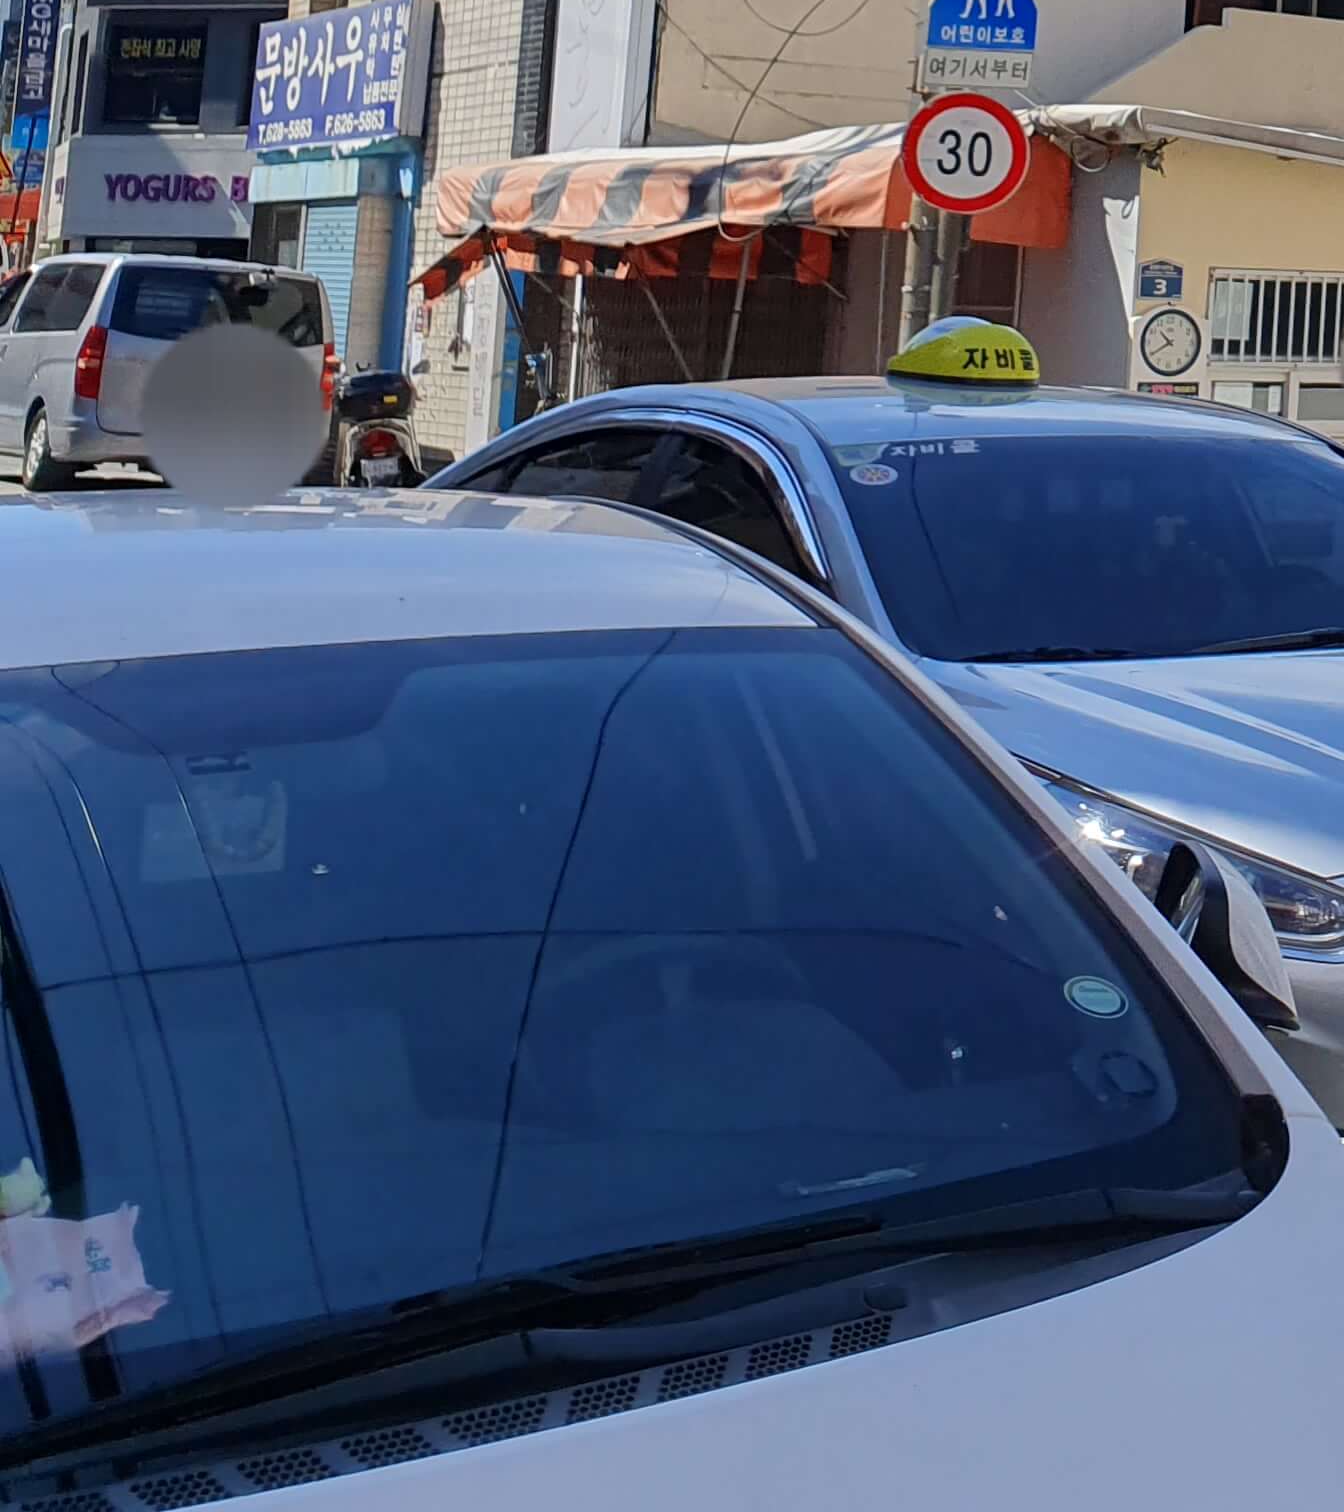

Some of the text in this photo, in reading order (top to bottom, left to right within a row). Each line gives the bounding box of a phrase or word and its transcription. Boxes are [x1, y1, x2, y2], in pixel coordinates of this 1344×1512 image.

[940, 24, 1026, 45] 어린이보호
[255, 15, 364, 116] 문방사우
[928, 55, 1030, 82] 여기서부터
[936, 128, 993, 178] 30
[103, 173, 216, 203] YOGURS
[1152, 278, 1168, 295] 3
